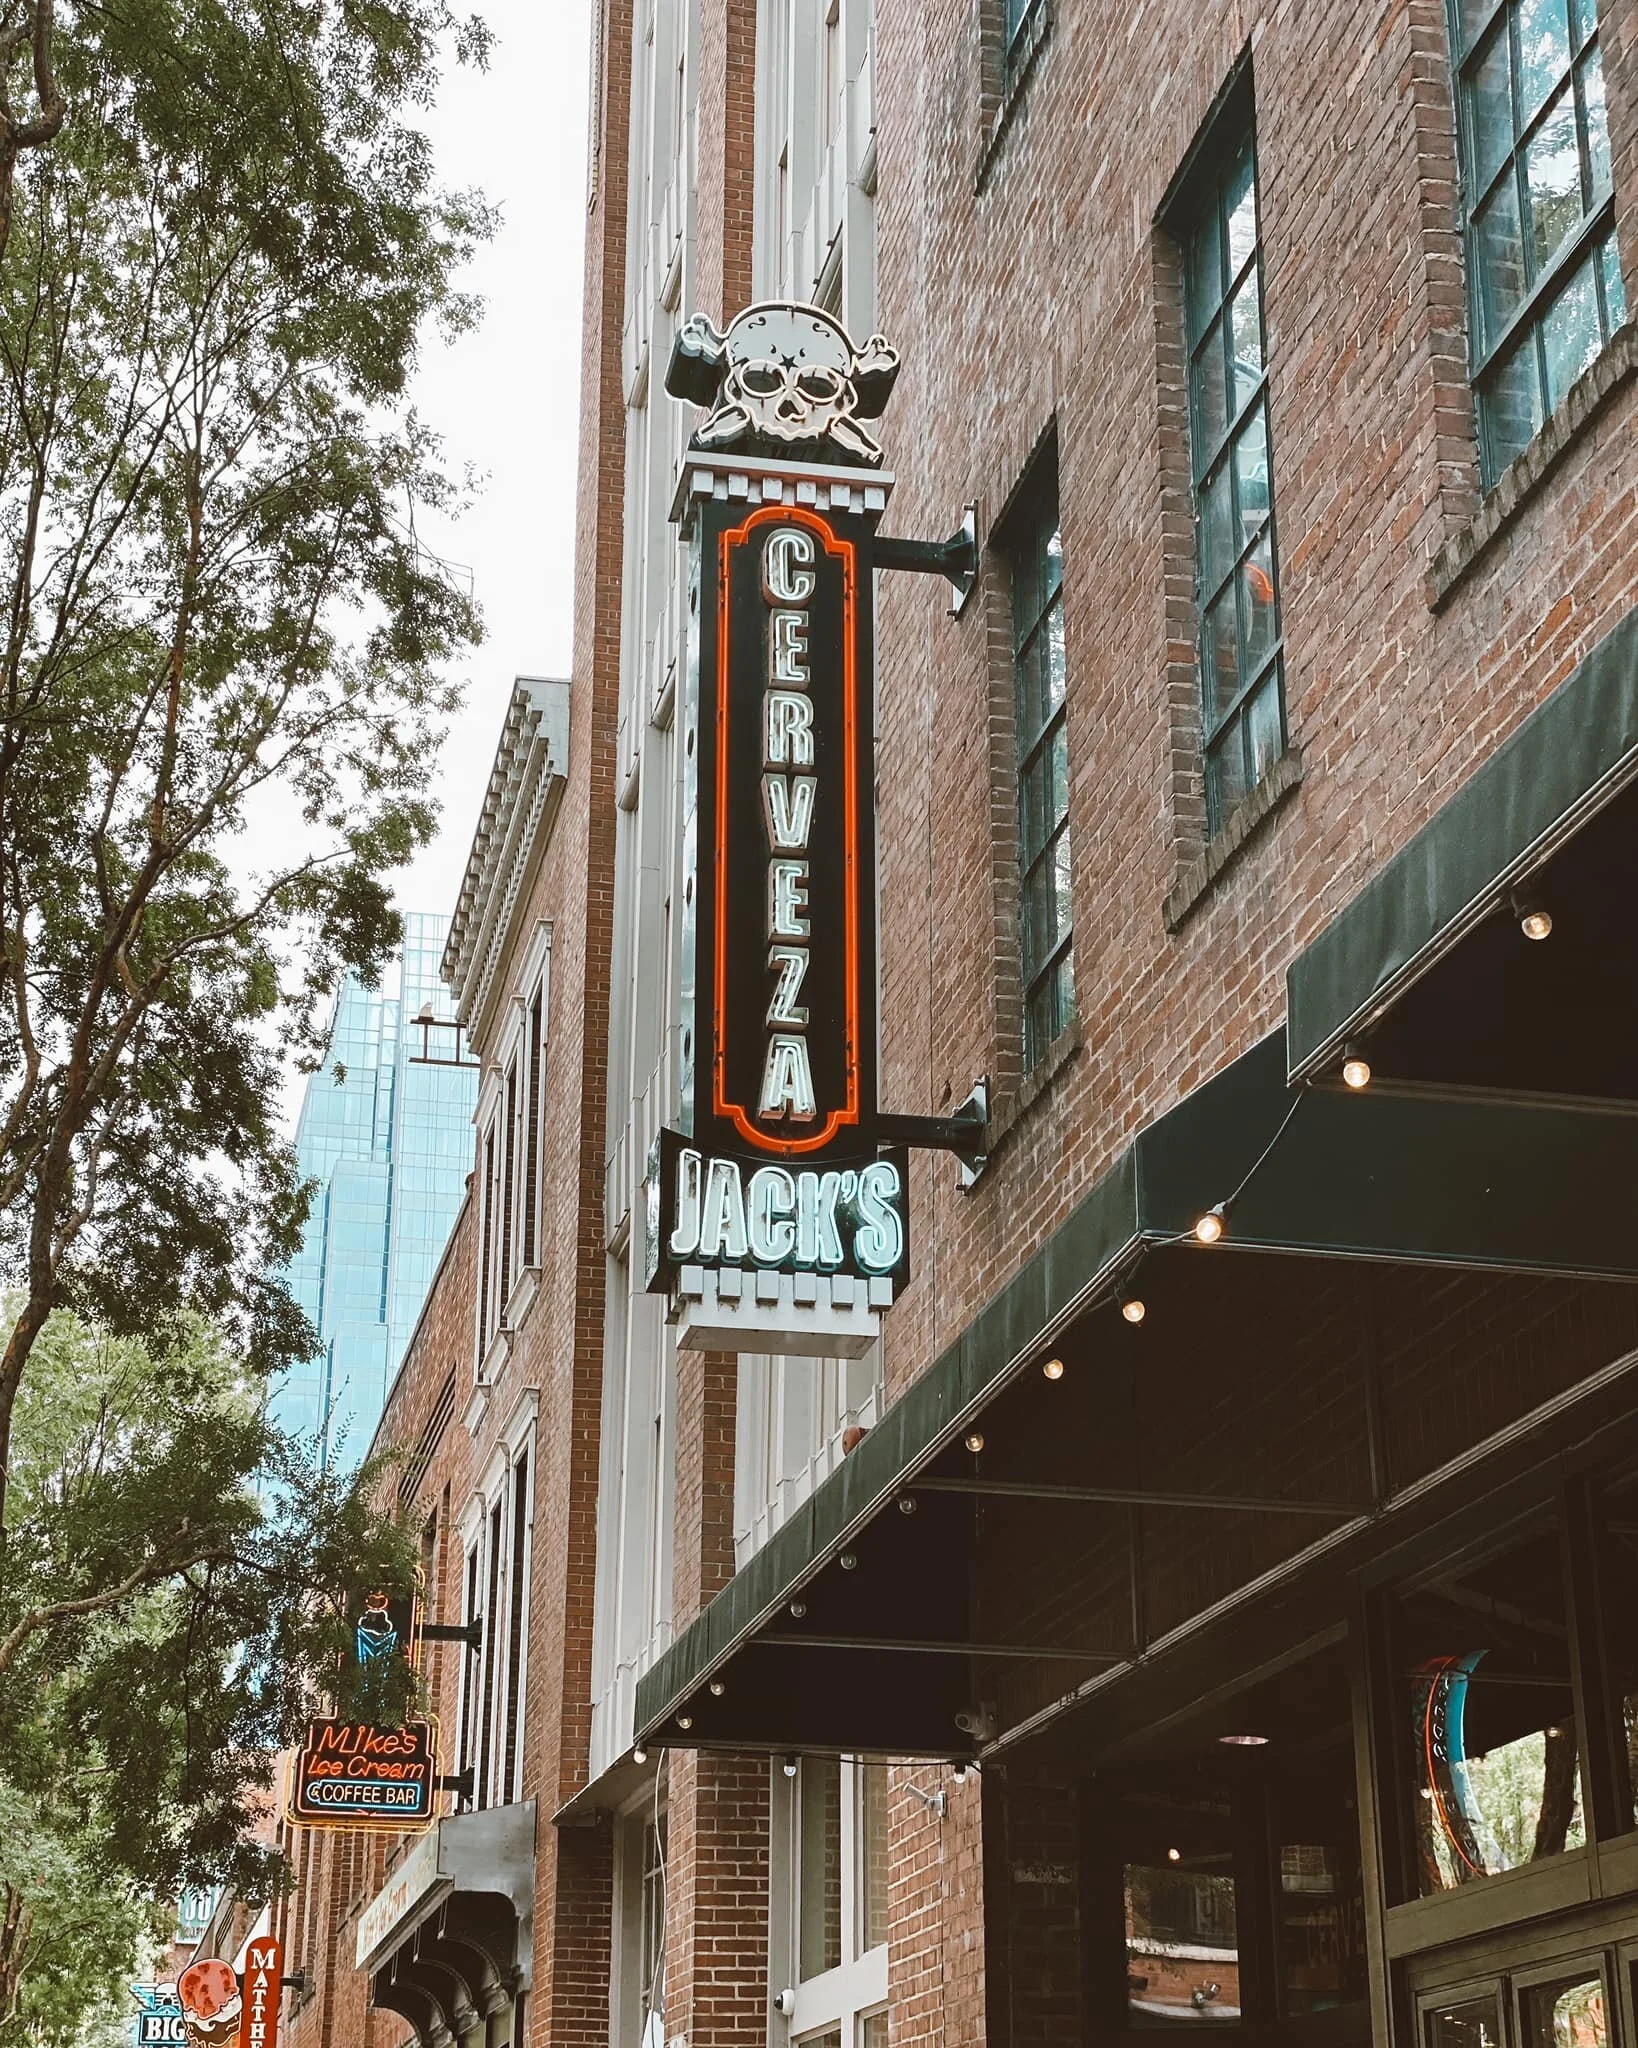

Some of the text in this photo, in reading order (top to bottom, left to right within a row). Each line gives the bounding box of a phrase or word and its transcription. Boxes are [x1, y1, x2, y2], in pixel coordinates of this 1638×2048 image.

[761, 528, 817, 1121] CERVEZA
[670, 1148, 903, 1269] JACK'S
[307, 1754, 425, 1779] Ice Cream
[322, 1784, 382, 1803] COFFEE
[385, 1787, 416, 1805] BAR
[145, 2017, 186, 2041] BIG
